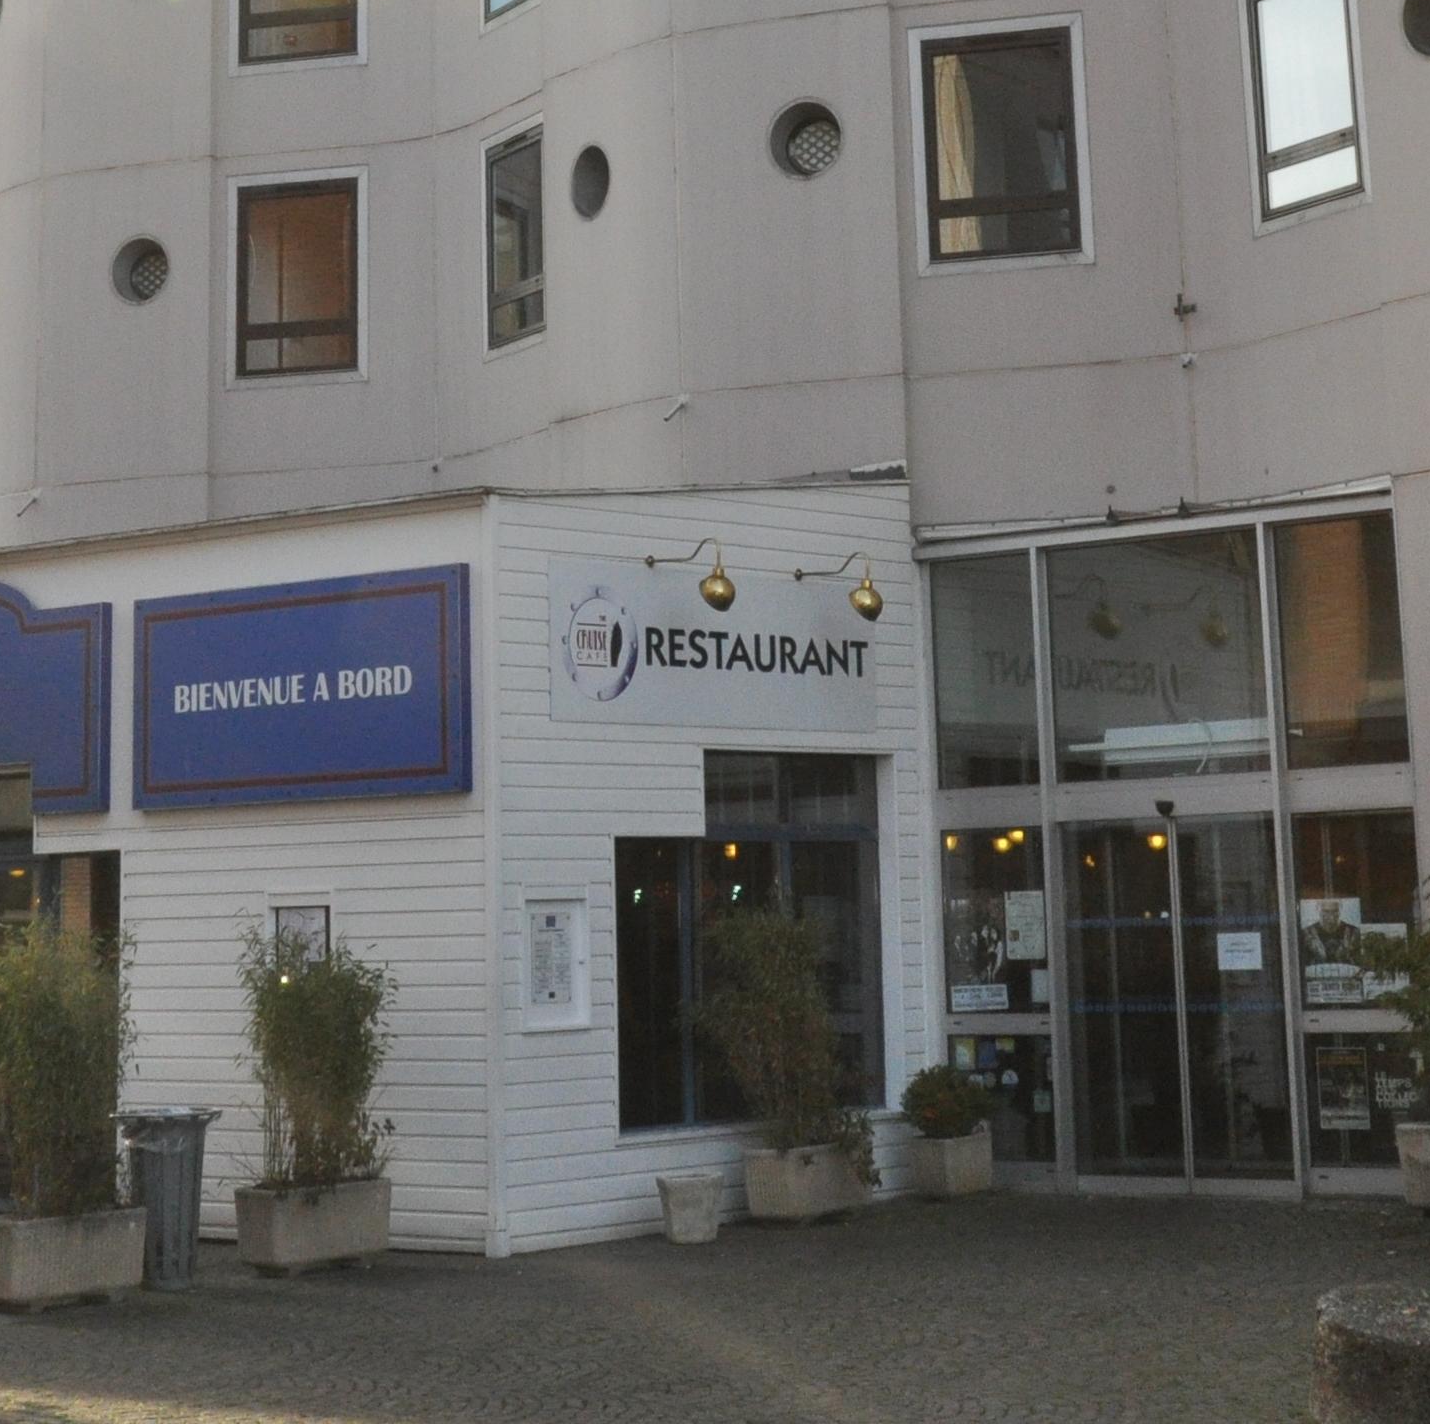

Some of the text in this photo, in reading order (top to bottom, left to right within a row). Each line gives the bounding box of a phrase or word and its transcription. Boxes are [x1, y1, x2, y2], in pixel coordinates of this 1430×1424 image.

[645, 626, 869, 678] RESTAURANT
[173, 664, 413, 714] BIENVENUE A BORD
